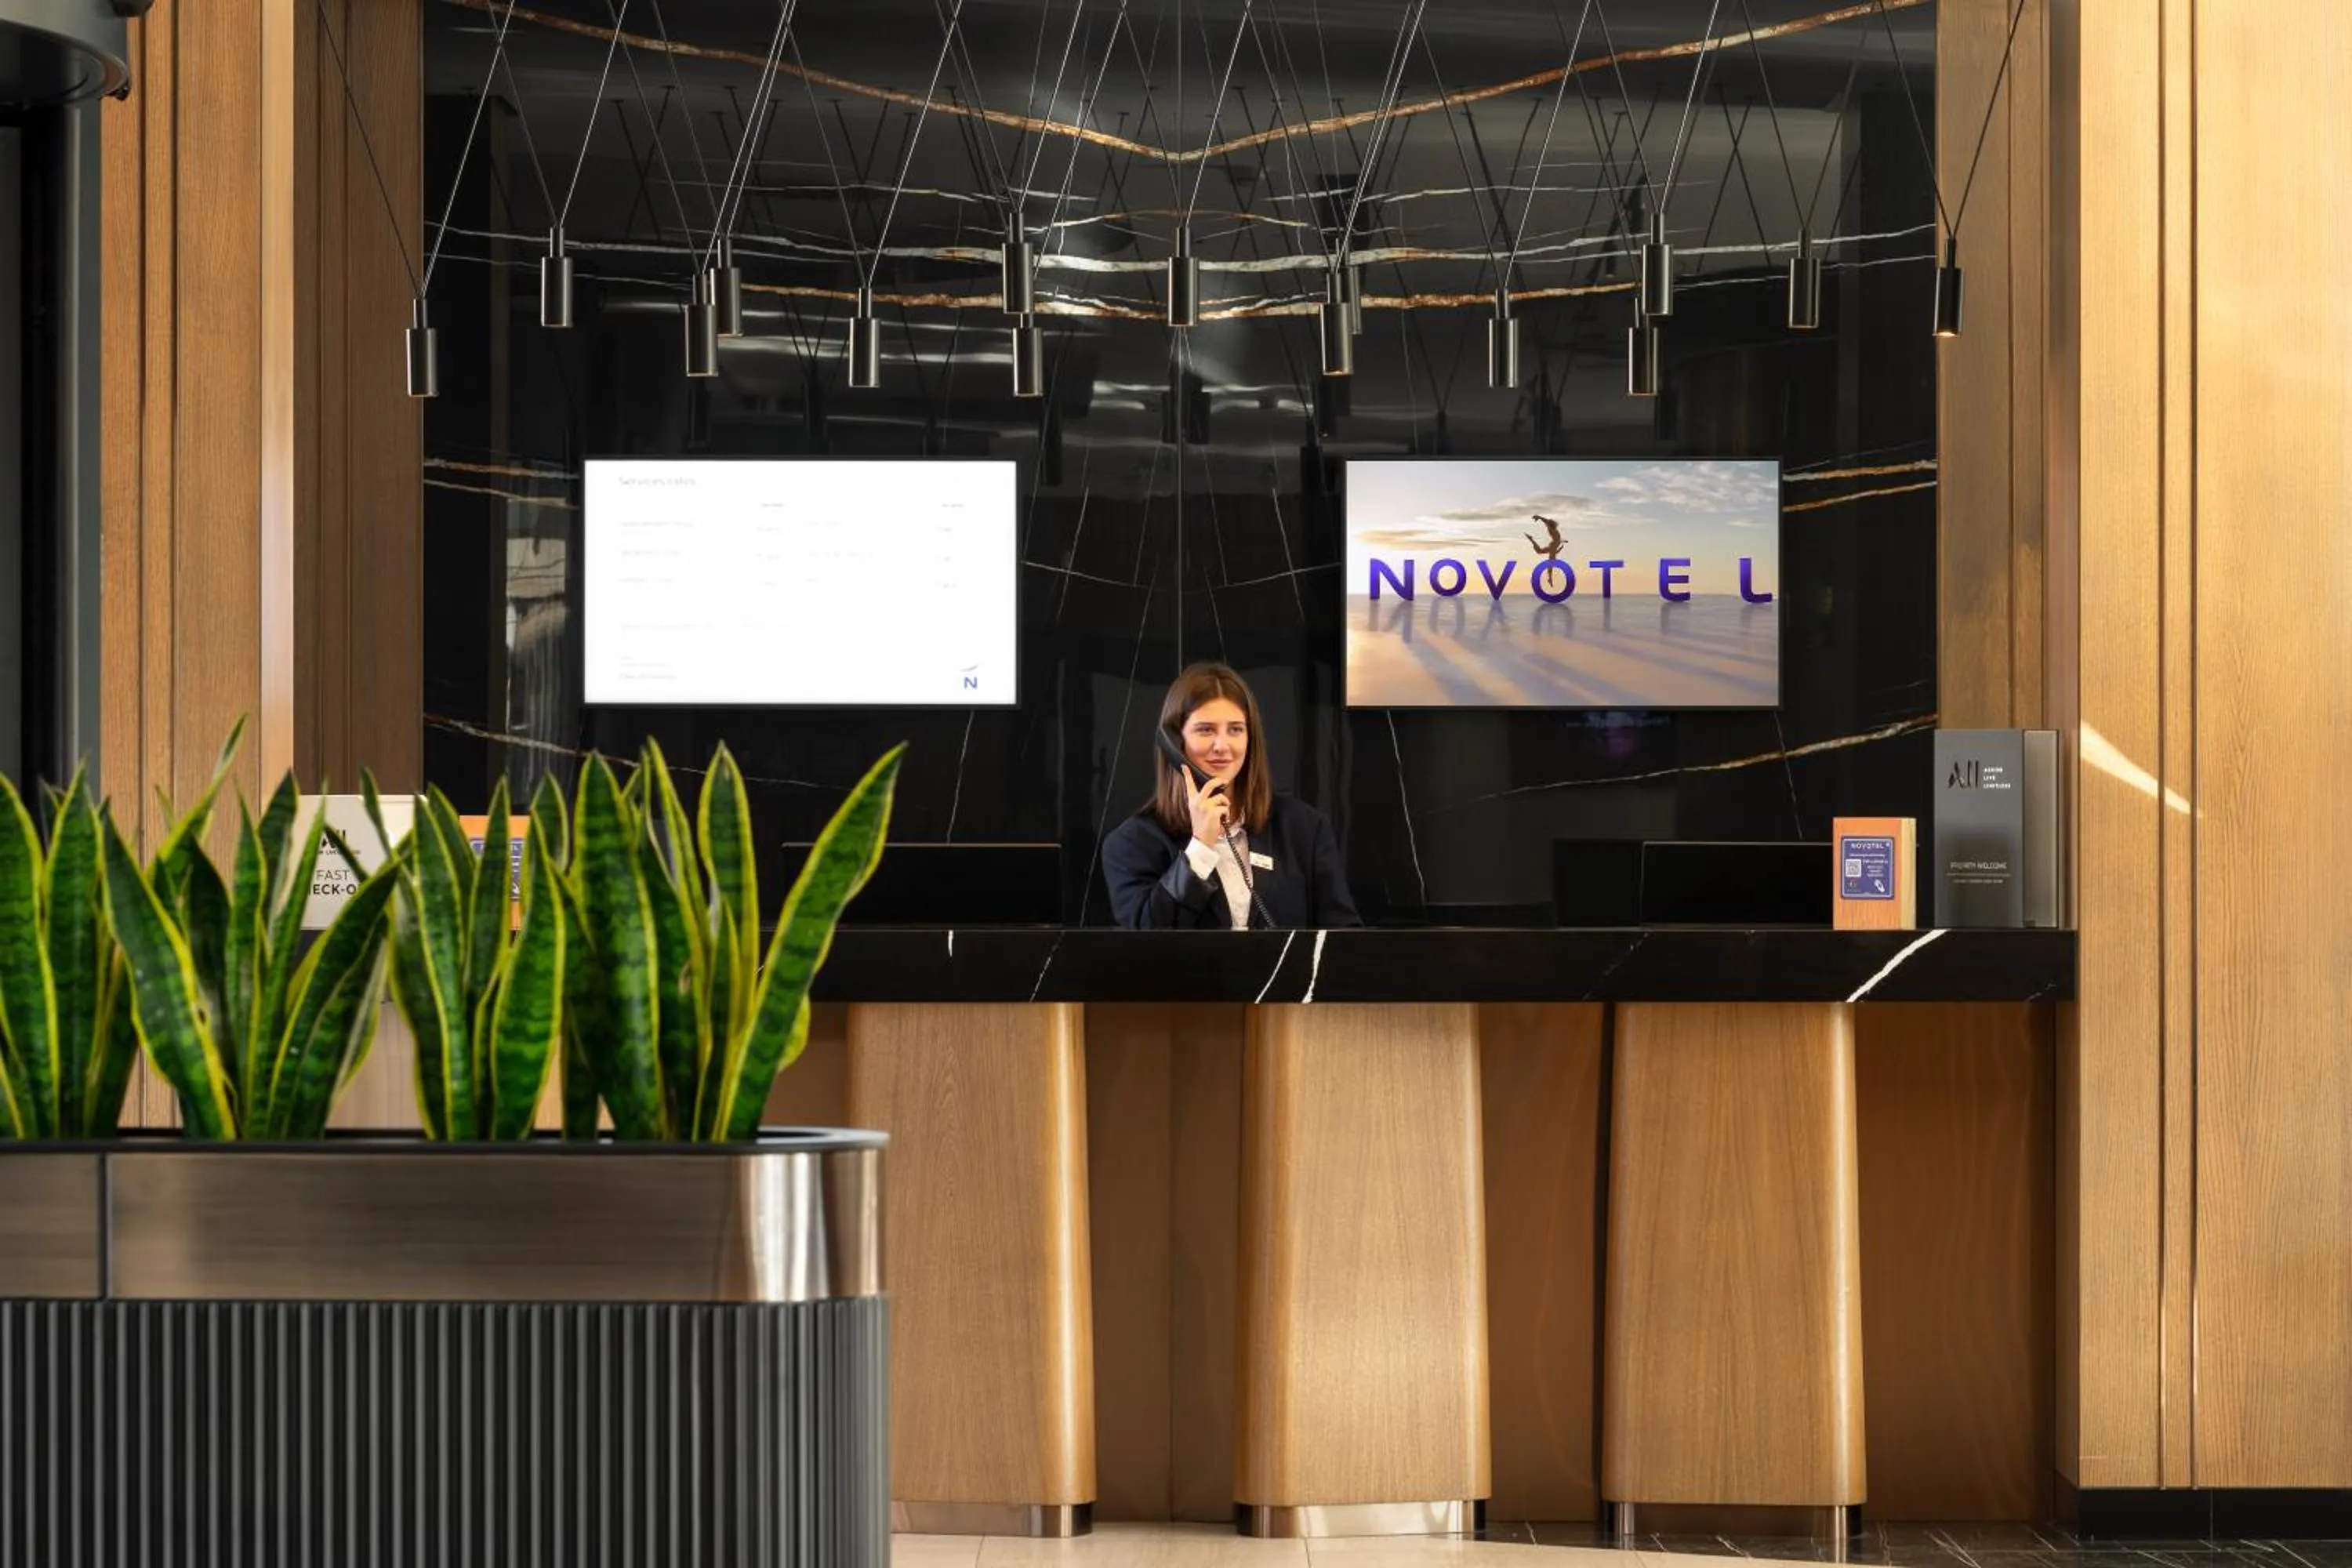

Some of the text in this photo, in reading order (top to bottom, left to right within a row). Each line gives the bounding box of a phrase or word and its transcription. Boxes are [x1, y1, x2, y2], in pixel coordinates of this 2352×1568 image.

[1369, 557, 1773, 604] NOVOTEL
[964, 677, 978, 689] N
[316, 869, 350, 880] FAST
[310, 884, 358, 895] ECK-O
